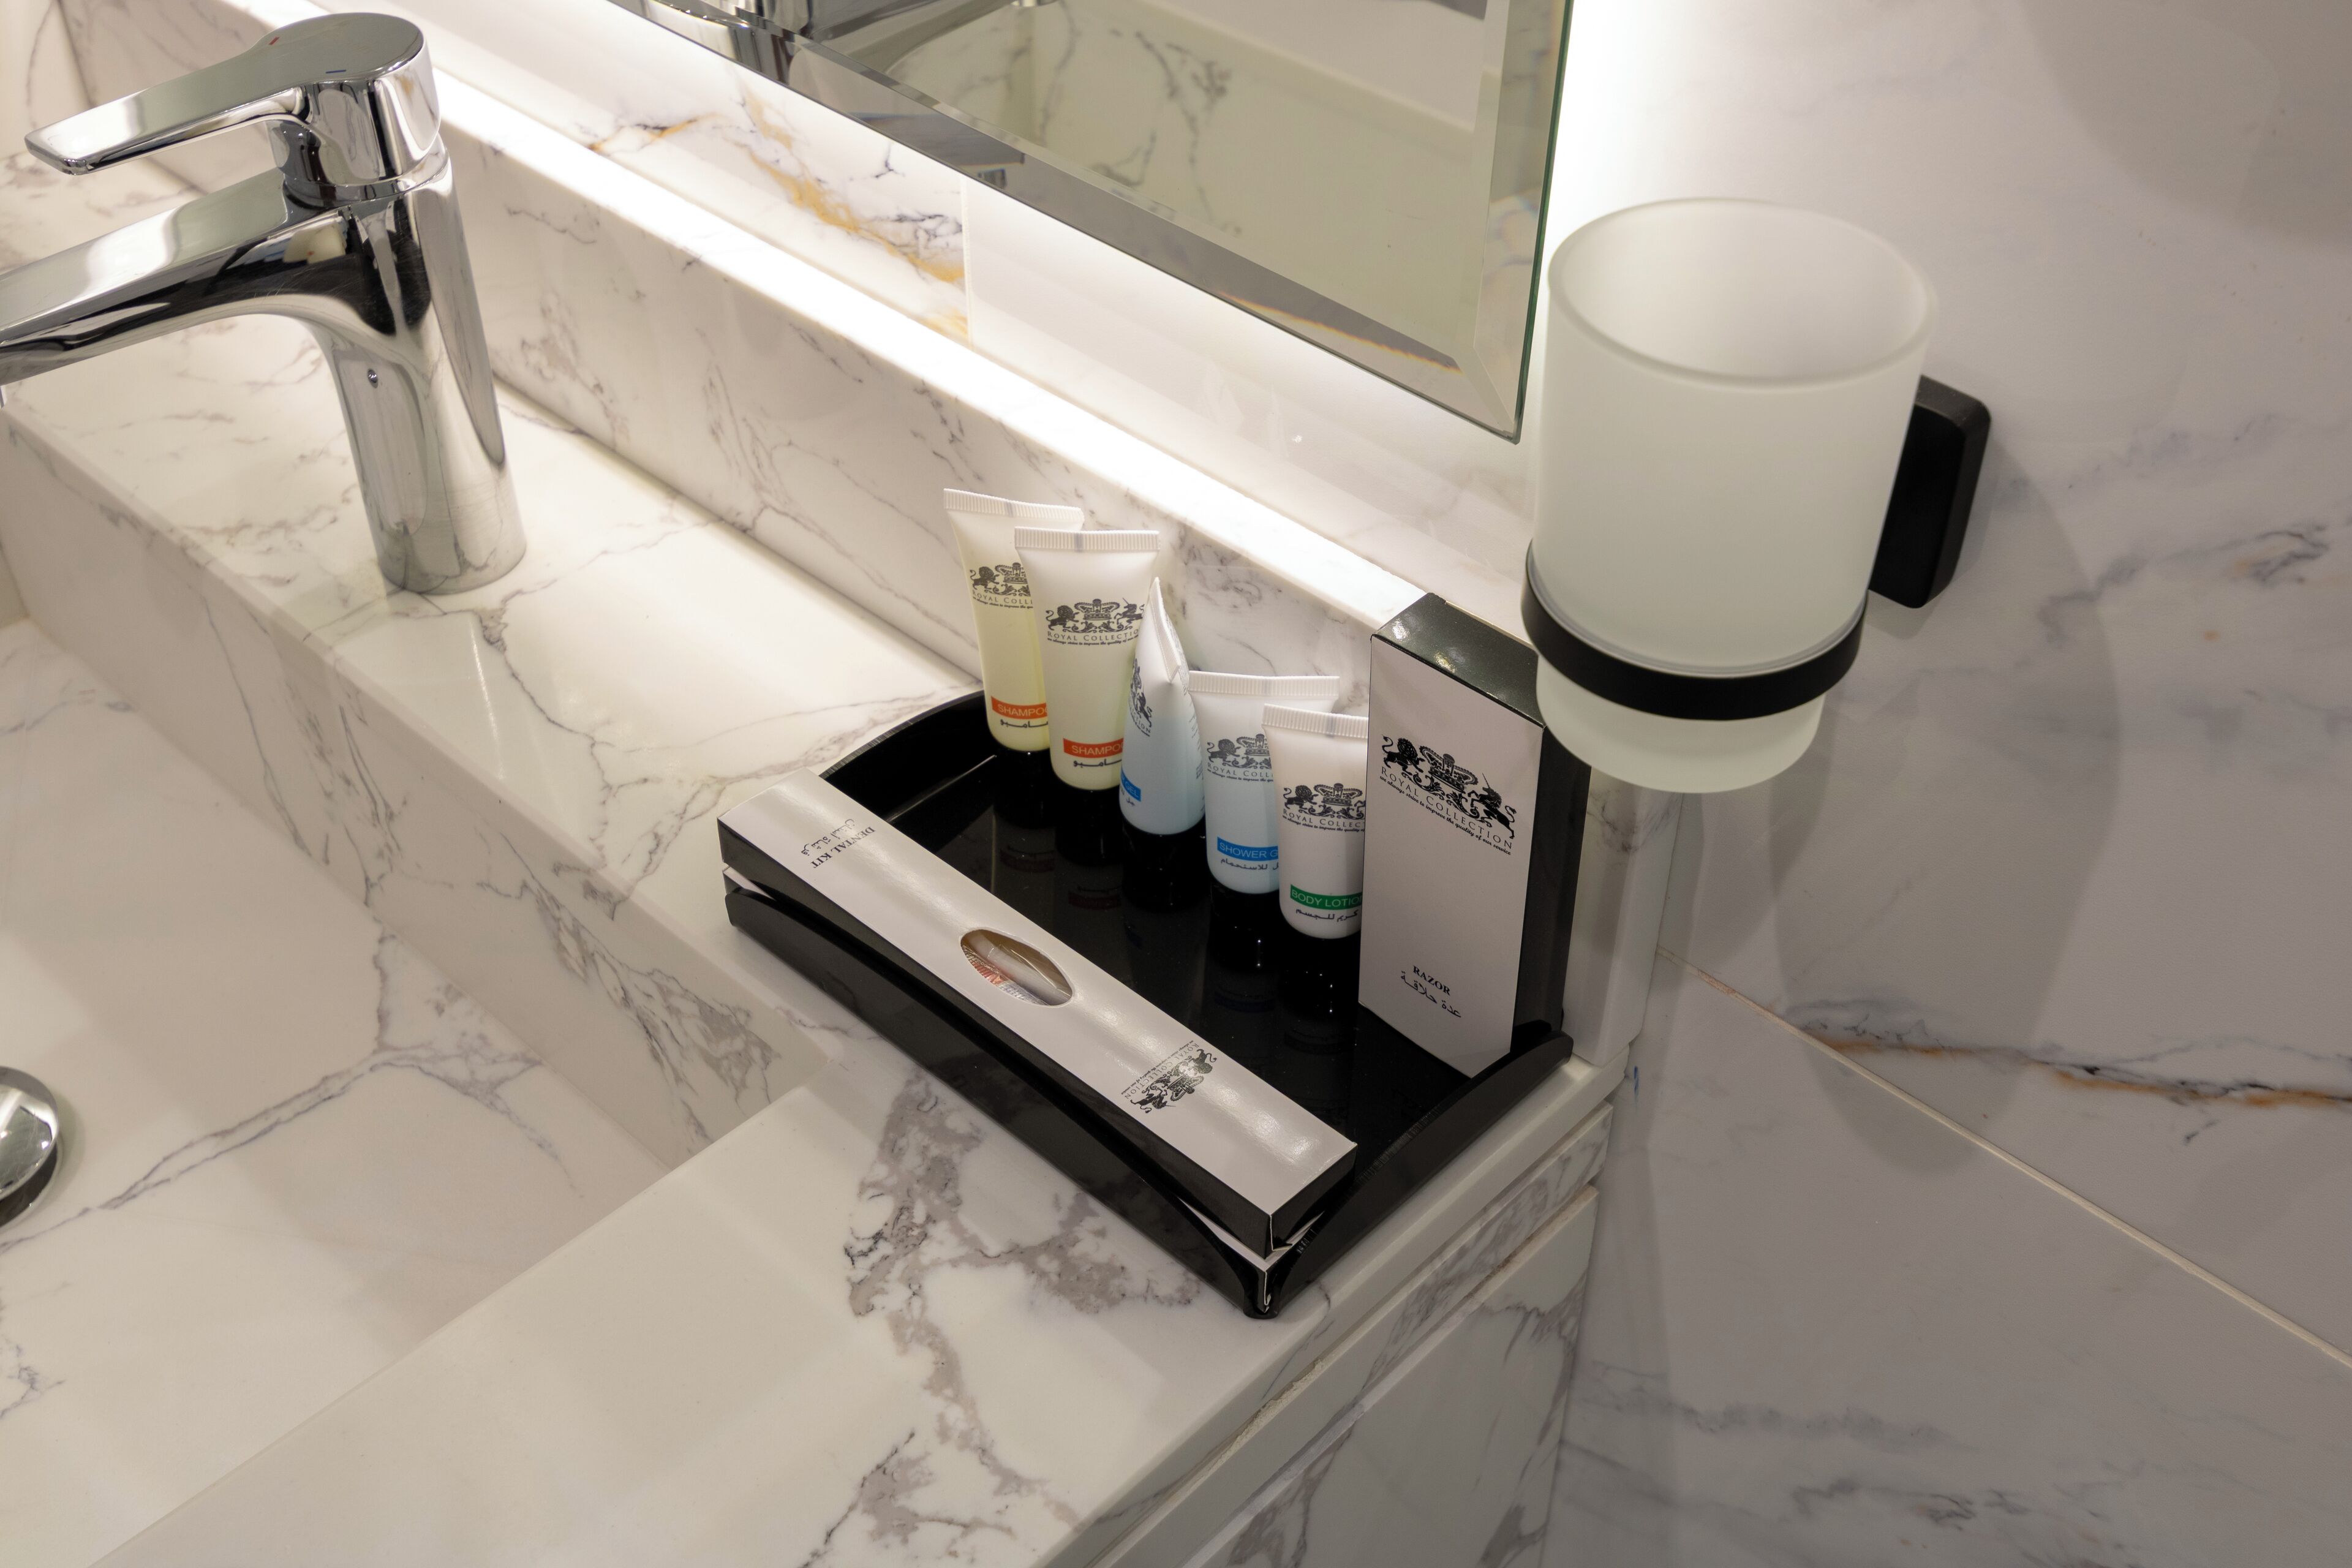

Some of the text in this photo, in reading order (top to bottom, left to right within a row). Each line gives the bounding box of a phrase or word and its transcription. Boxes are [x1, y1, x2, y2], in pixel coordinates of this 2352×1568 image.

[972, 589, 998, 602] ROYAL
[1047, 631, 1077, 641] ROYAL
[1084, 629, 1138, 641] COLLECTIO
[1071, 743, 1123, 755] SHAMPO
[1208, 762, 1237, 775] ROYAL
[1381, 766, 1512, 850] ROYAL COLLECTION
[1283, 809, 1365, 827] ROYAL COLLEC
[1387, 781, 1405, 794] always
[1406, 793, 1419, 804] strive
[1425, 804, 1446, 820] improve
[1455, 823, 1474, 837] quality
[1493, 844, 1511, 856] service
[801, 836, 831, 856] فرشاة
[810, 826, 876, 869] DENTAL KIT
[1219, 842, 1267, 858] SHOWER
[1291, 889, 1322, 905] BODY
[1413, 965, 1451, 996] RAZOR
[1400, 970, 1462, 1018] عدة حلاقة
[1174, 1043, 1199, 1060] ROYAL
[1125, 1061, 1173, 1099] COLLECTION
